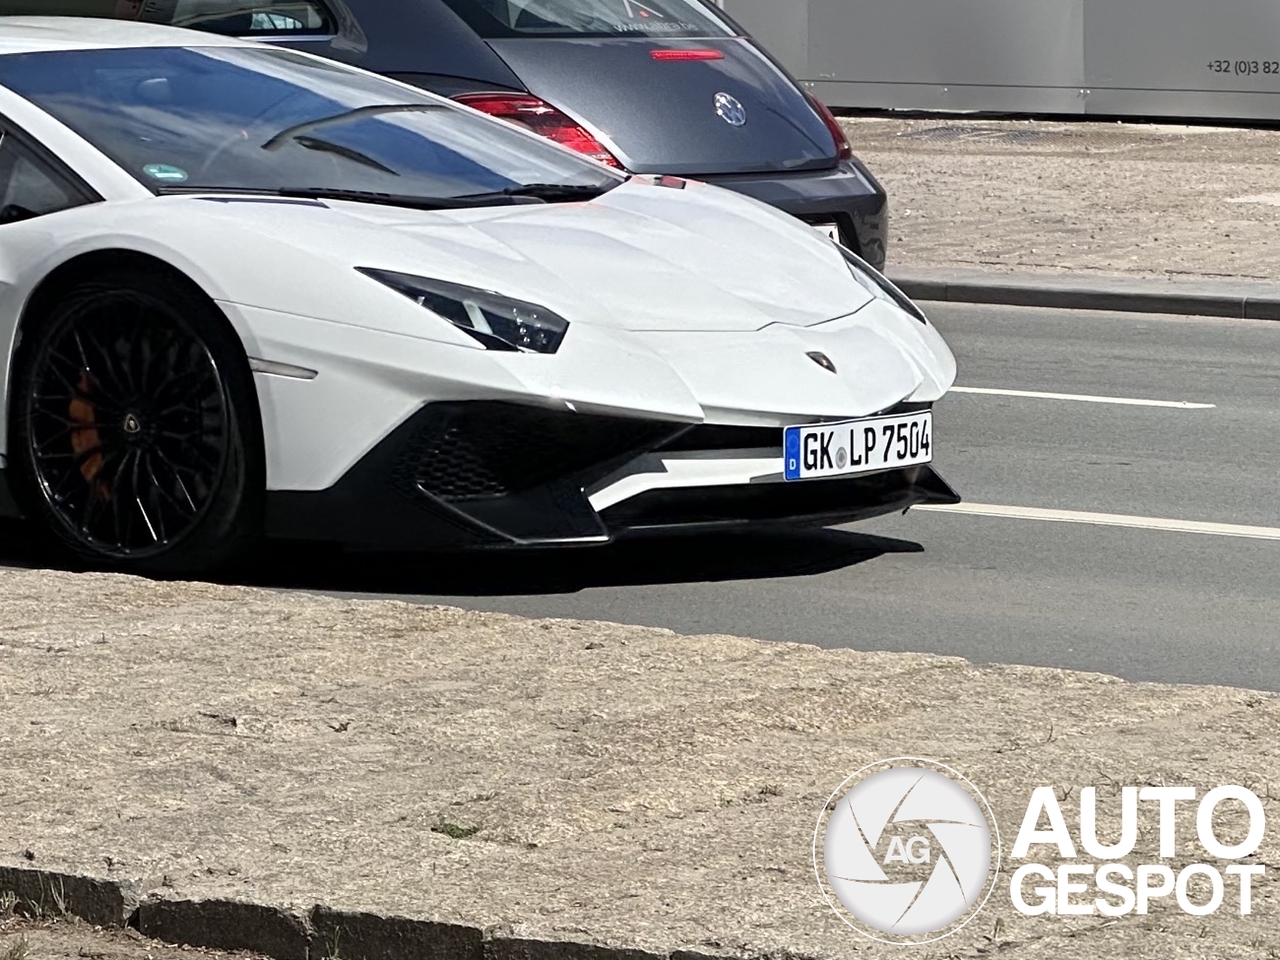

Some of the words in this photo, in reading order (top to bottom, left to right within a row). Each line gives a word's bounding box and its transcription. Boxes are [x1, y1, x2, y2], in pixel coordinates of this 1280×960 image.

[1206, 60, 1231, 73] +32
[1234, 60, 1259, 76] (0)3
[1262, 61, 1280, 74] 82
[803, 431, 834, 471] GK
[850, 427, 877, 466] LP
[882, 419, 930, 463] 7504
